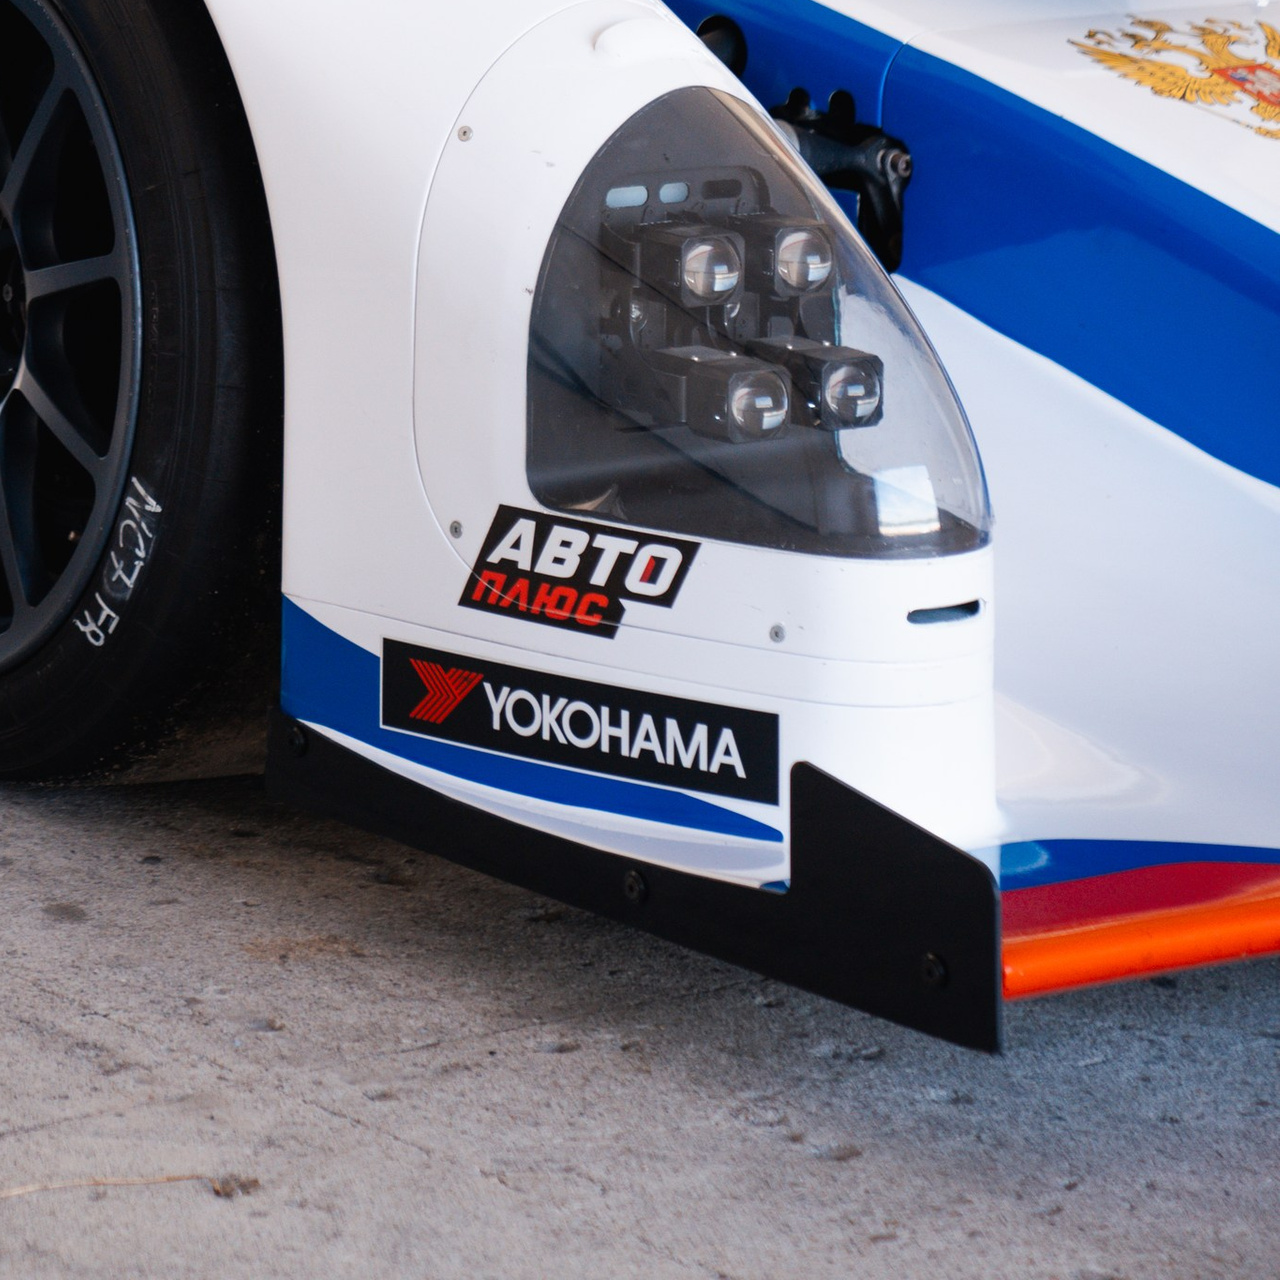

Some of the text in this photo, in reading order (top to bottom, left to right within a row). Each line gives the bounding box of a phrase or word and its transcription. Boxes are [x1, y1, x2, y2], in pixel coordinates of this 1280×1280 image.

[471, 569, 610, 627] ПЛЮС
[486, 518, 684, 598] АВТО
[482, 681, 748, 779] YOKOHAMA
